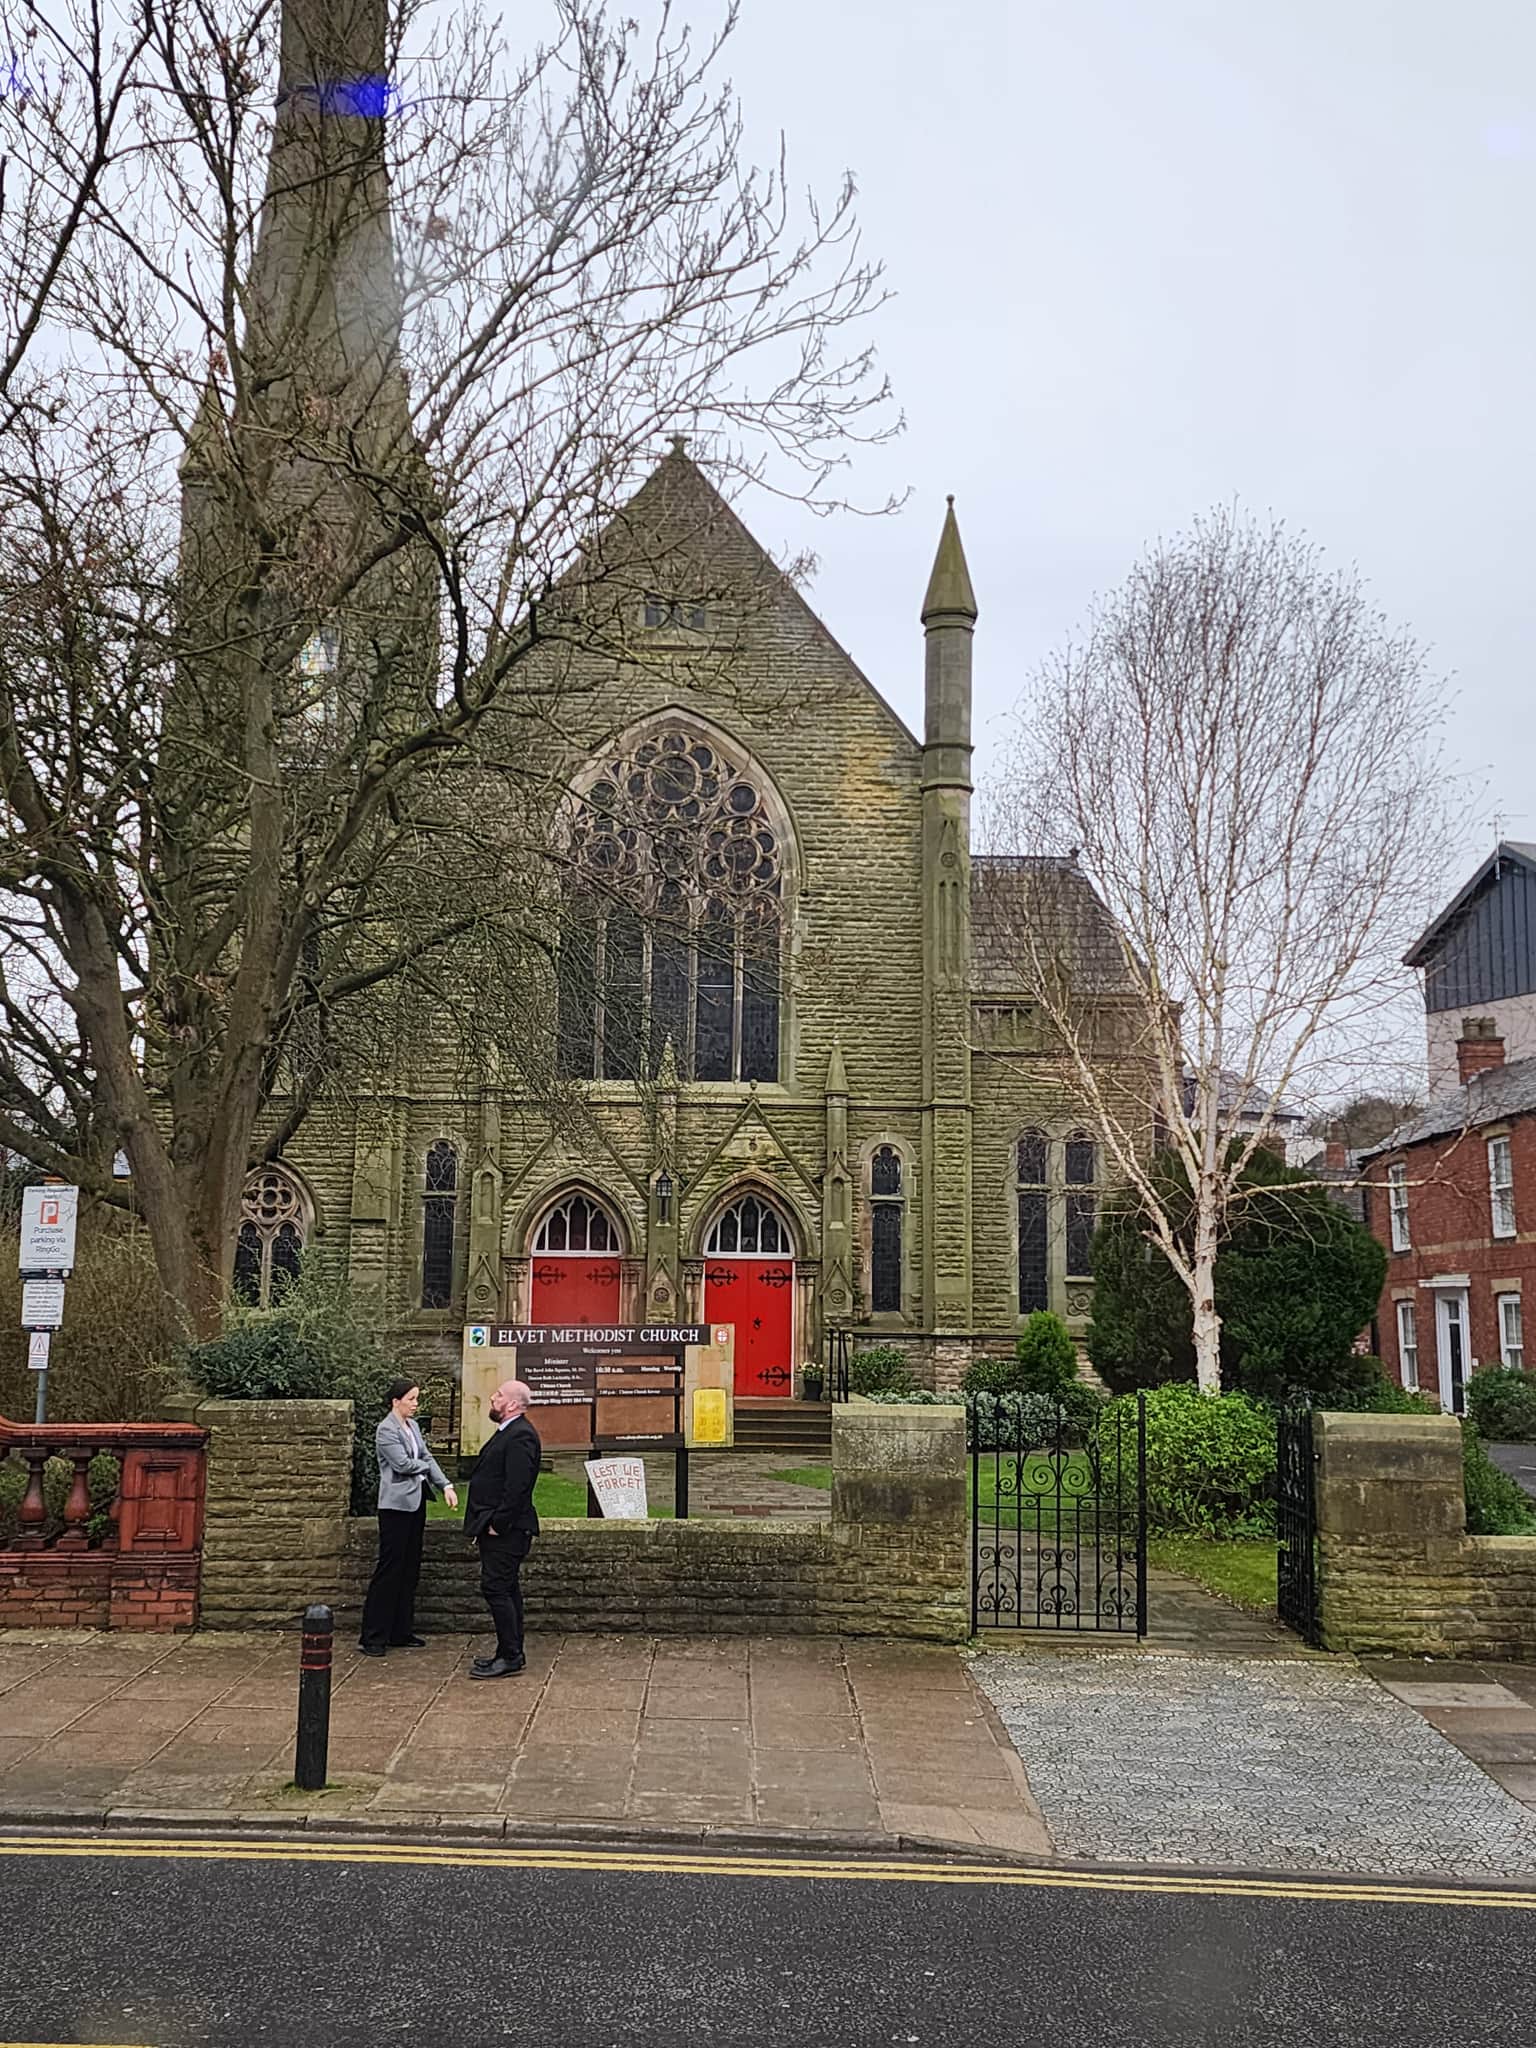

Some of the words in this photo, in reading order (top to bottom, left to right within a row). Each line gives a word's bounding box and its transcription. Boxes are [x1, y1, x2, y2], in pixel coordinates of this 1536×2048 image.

[33, 1226, 64, 1234] Purchase
[30, 1237, 55, 1245] parking
[35, 1246, 60, 1254] RingGo
[498, 1329, 547, 1343] ELVET
[551, 1329, 635, 1343] METHODIST
[640, 1328, 700, 1342] CHURCH
[592, 1463, 618, 1478] LEST
[623, 1463, 640, 1476] WE
[596, 1477, 641, 1492] FORGET
